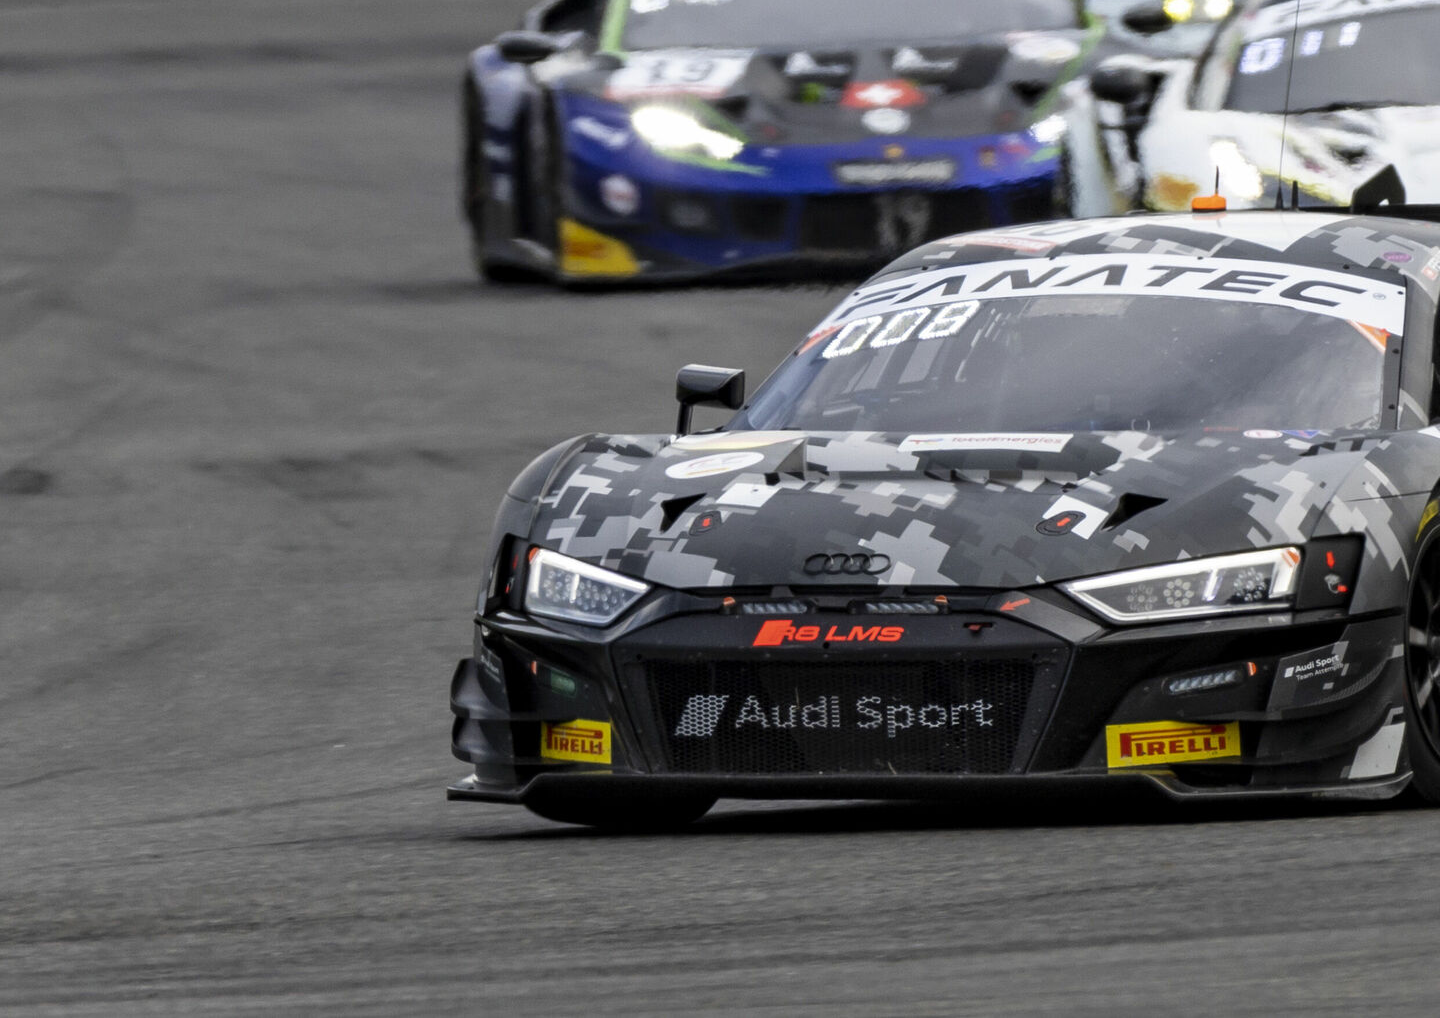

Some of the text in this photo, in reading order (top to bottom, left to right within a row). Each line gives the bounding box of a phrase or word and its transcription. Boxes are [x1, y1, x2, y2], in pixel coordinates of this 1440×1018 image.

[837, 264, 1371, 320] FANATEC
[822, 300, 980, 358] 008
[824, 625, 905, 642] LMS
[1294, 654, 1340, 673] Audi Sport
[1296, 672, 1314, 681] Team
[735, 695, 993, 738] Audi Sport
[546, 724, 604, 756] PIRELLI
[1119, 725, 1227, 759] PIRELLI
